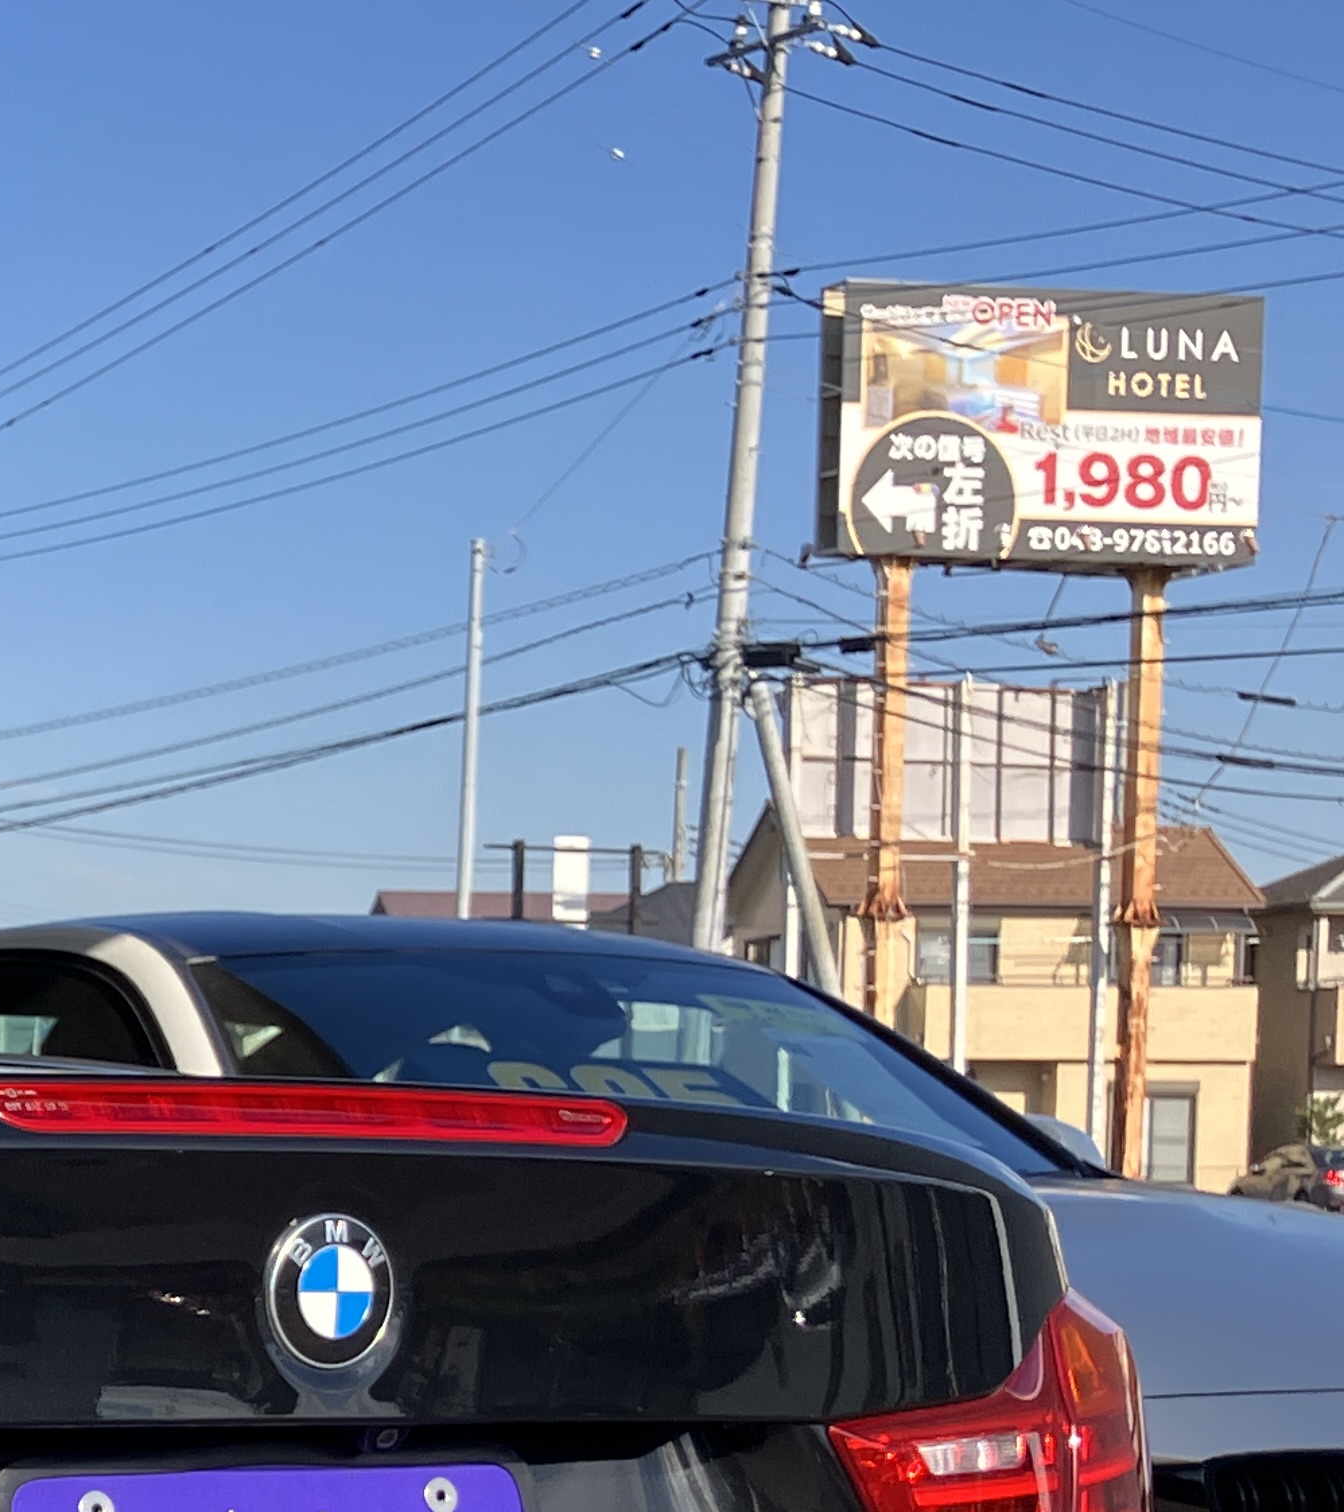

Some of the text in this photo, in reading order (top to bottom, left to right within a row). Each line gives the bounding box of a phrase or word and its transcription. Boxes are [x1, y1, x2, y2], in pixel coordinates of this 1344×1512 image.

[973, 300, 1056, 328] OPEN
[1121, 326, 1240, 362] LUNA
[1108, 371, 1207, 400] HOTEL
[888, 433, 986, 463] 次の信号
[1020, 423, 1071, 443] Rest
[1035, 452, 1212, 511] 1,980
[941, 462, 985, 551] 左折
[289, 1219, 385, 1268] BMW
